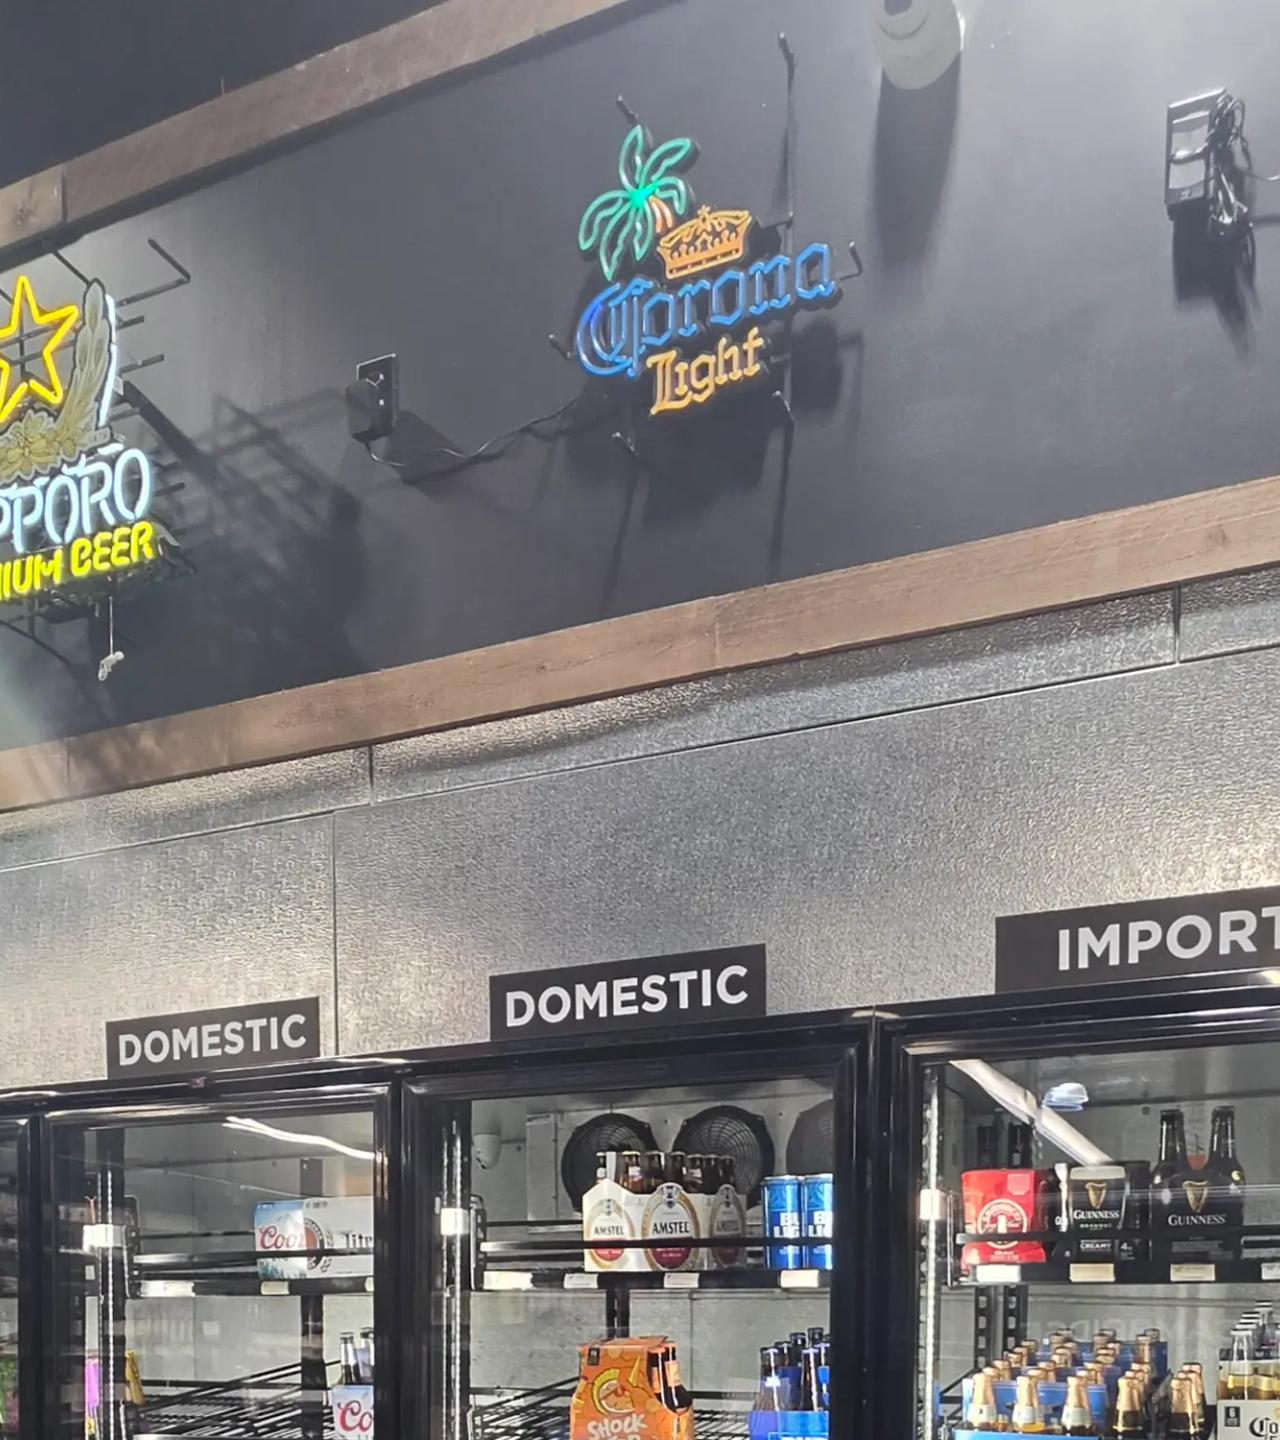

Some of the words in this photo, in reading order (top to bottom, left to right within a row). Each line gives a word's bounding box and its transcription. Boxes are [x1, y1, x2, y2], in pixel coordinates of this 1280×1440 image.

[577, 243, 837, 378] Corona
[646, 327, 765, 416] Light
[71, 520, 155, 578] BEER
[505, 964, 749, 1029] DOMESTIC
[119, 1013, 308, 1066] DOMESTIC
[652, 1221, 690, 1234] AMSTEL
[1073, 1207, 1120, 1220] GUINNESS
[1168, 1213, 1226, 1226] GUINNESS
[593, 1225, 625, 1236] AMSTEL
[1228, 1408, 1236, 1418] 6
